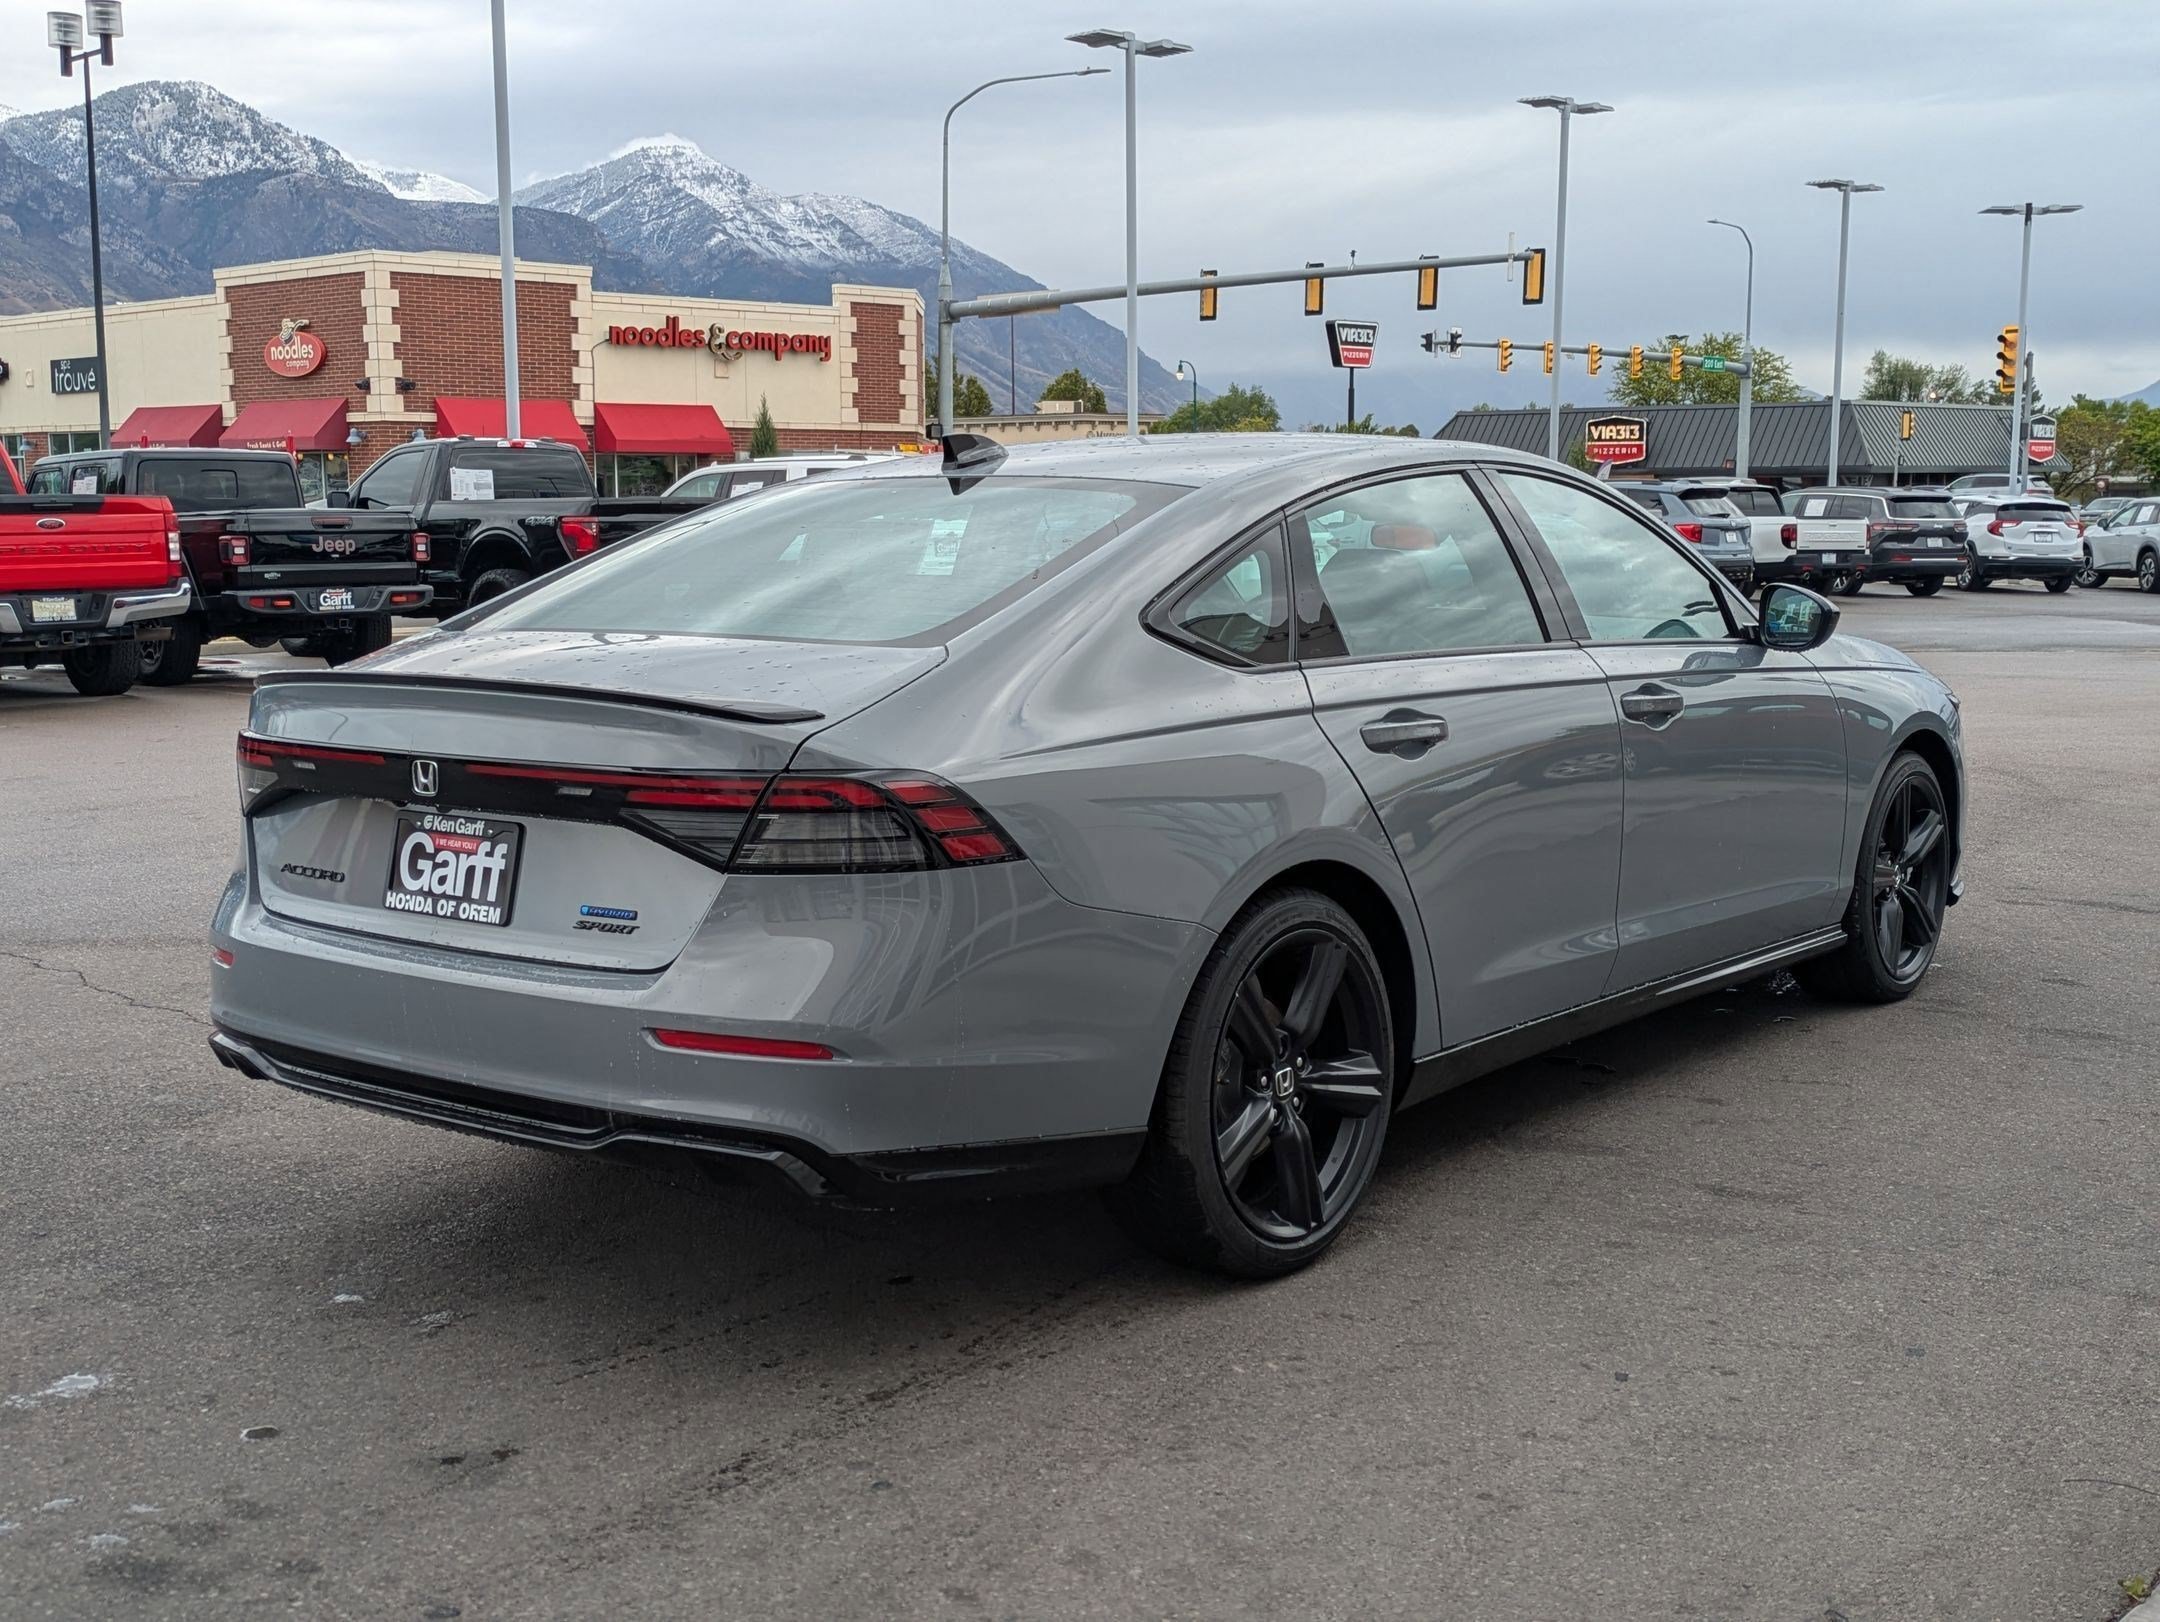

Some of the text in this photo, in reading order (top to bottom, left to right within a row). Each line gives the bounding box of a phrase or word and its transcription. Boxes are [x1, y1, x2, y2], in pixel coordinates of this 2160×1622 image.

[609, 315, 705, 348] noodles
[726, 330, 832, 362] company
[1339, 327, 1374, 344] VIA313
[270, 335, 314, 360] noodles
[54, 367, 97, 392] trouvé
[1590, 425, 1640, 440] VIA313
[1593, 447, 1638, 455] PIZZERIA
[311, 536, 356, 554] Jeep
[319, 592, 352, 606] Garff
[432, 816, 485, 836] Ken Garff
[280, 863, 345, 883] ACCORD
[400, 831, 508, 902] Garff
[385, 891, 501, 924] HONDA OF OREM
[572, 920, 640, 934] SPORT
